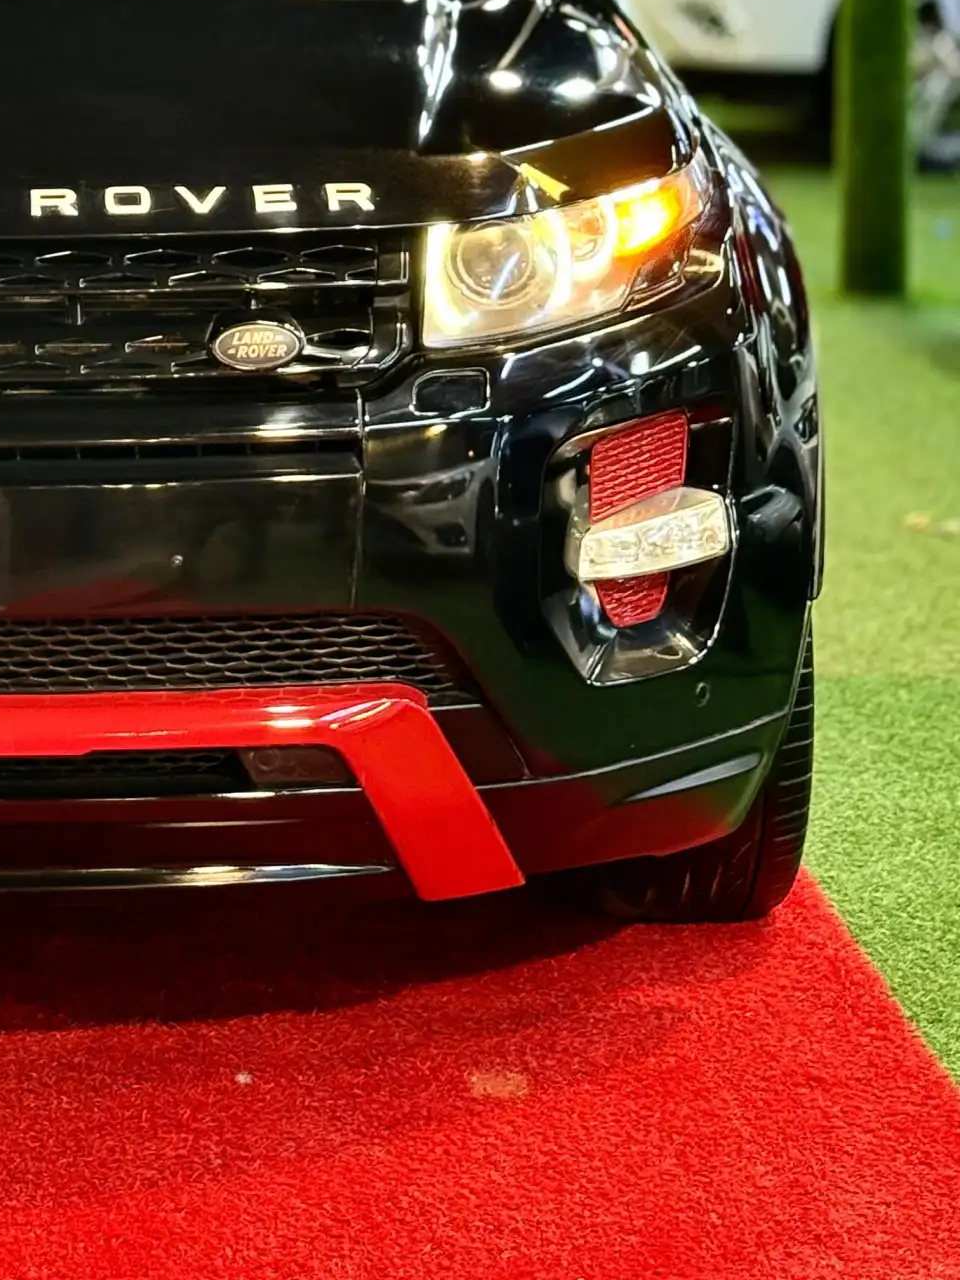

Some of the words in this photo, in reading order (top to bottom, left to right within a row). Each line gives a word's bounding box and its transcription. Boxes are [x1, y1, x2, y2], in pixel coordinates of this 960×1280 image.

[30, 182, 377, 216] ROVER
[231, 330, 275, 345] LAND
[236, 344, 288, 359] ROVER
